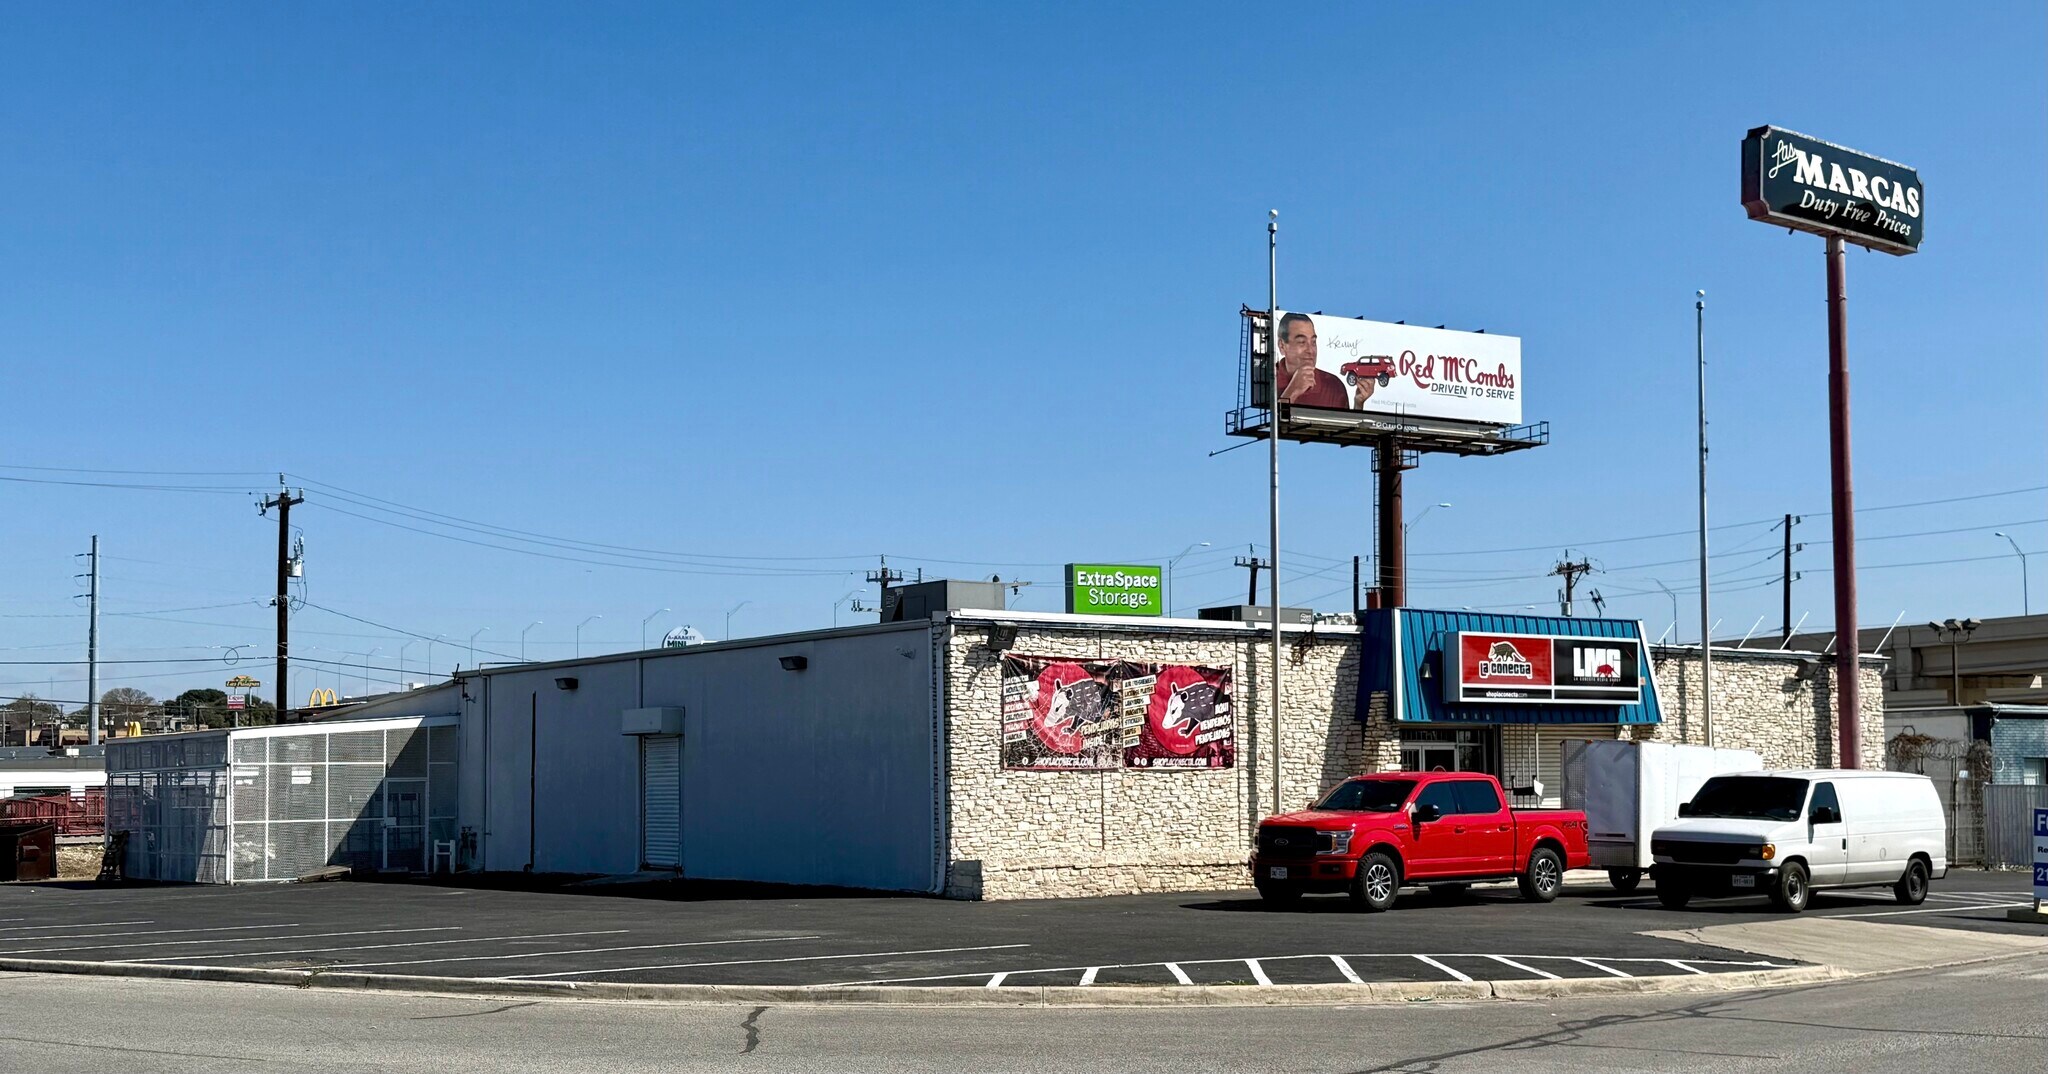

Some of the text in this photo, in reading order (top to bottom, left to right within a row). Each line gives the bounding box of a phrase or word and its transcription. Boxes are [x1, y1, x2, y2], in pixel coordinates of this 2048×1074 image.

[1768, 139, 1799, 179] Las
[1793, 150, 1920, 218] MARCAS
[1799, 189, 1911, 236] Duty Free Prices
[1399, 350, 1514, 389] Red McCombs
[1431, 383, 1515, 400] DRIVEN TO SERVE
[1573, 647, 1621, 678] LMG
[1195, 728, 1231, 746] PENDEJADAS
[1200, 715, 1232, 732] VENDEMOS
